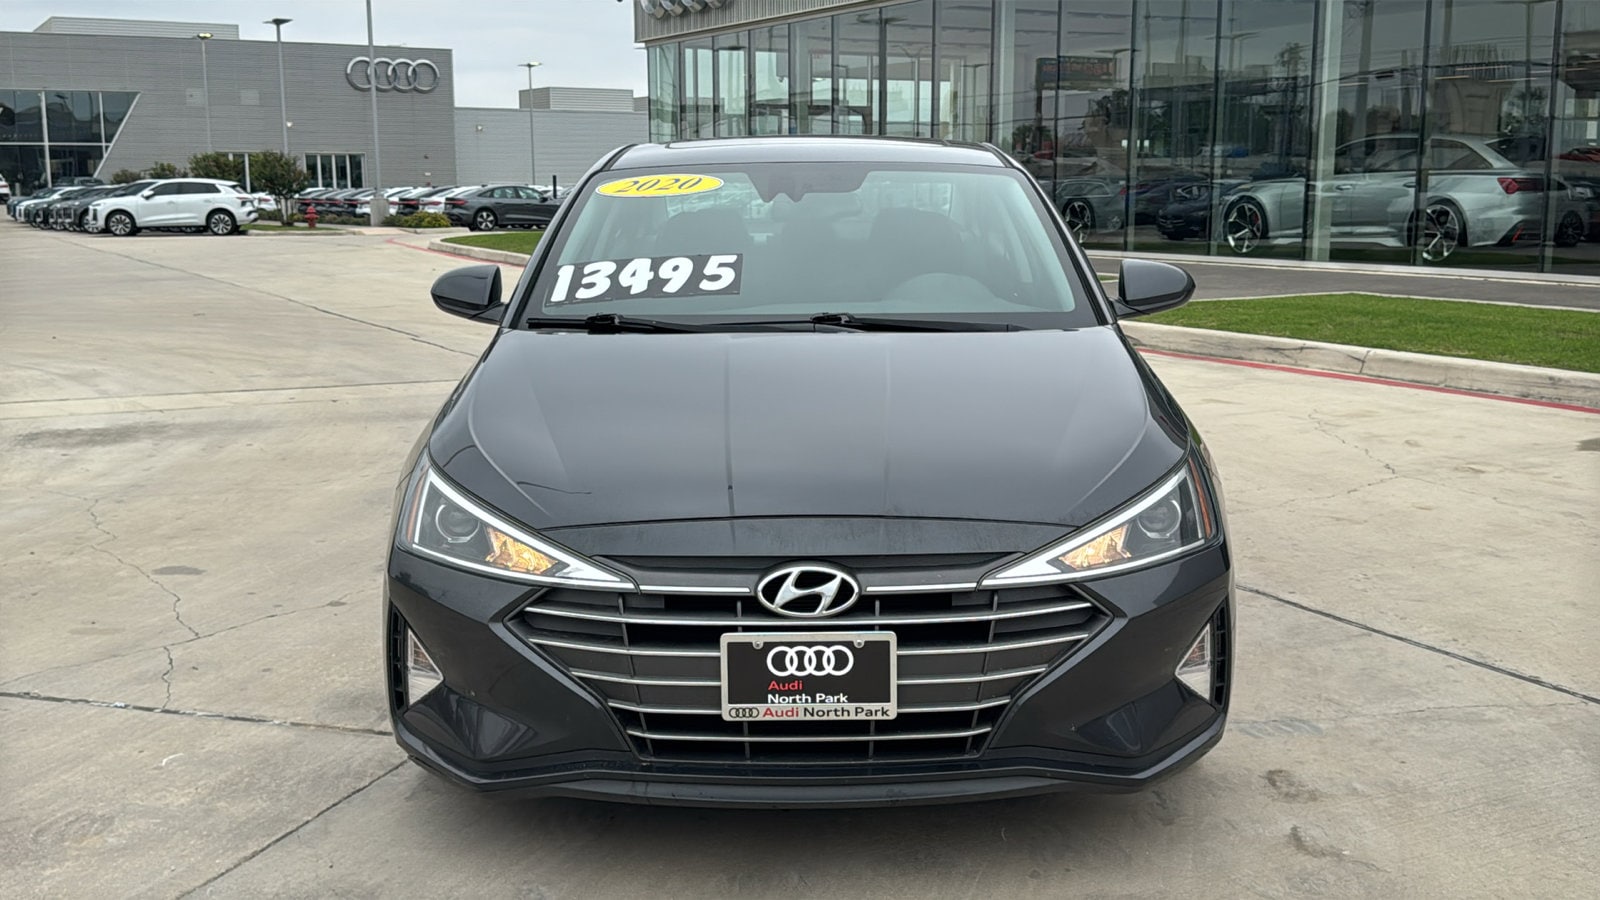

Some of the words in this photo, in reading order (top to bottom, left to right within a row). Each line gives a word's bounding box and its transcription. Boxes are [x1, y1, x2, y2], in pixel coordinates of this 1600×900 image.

[614, 176, 703, 193] 2020
[550, 254, 738, 302] 13495
[768, 680, 803, 691] Audi
[767, 693, 811, 704] North
[816, 692, 848, 704] Park
[762, 707, 799, 718] Audi
[803, 706, 850, 718] North
[854, 706, 890, 718] Park
